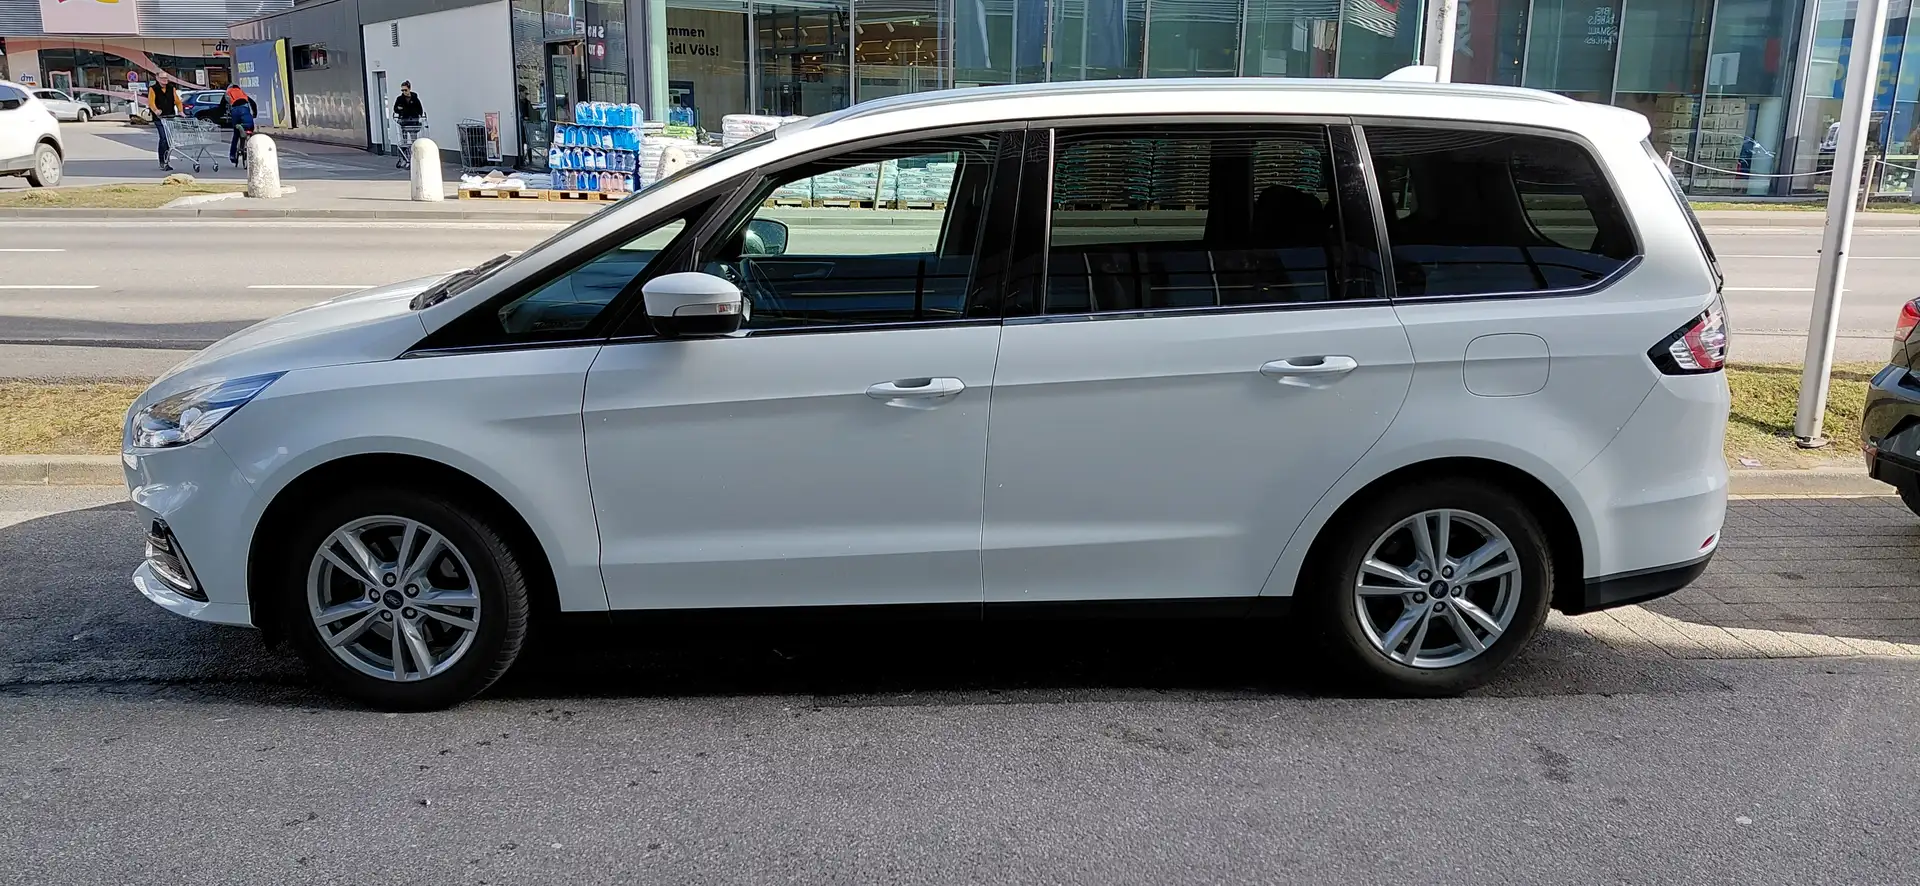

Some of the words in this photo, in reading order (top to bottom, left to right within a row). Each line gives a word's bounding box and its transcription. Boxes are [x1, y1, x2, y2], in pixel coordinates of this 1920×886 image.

[667, 42, 687, 55] idl
[689, 43, 719, 57] Völs!
[20, 73, 34, 82] dm
